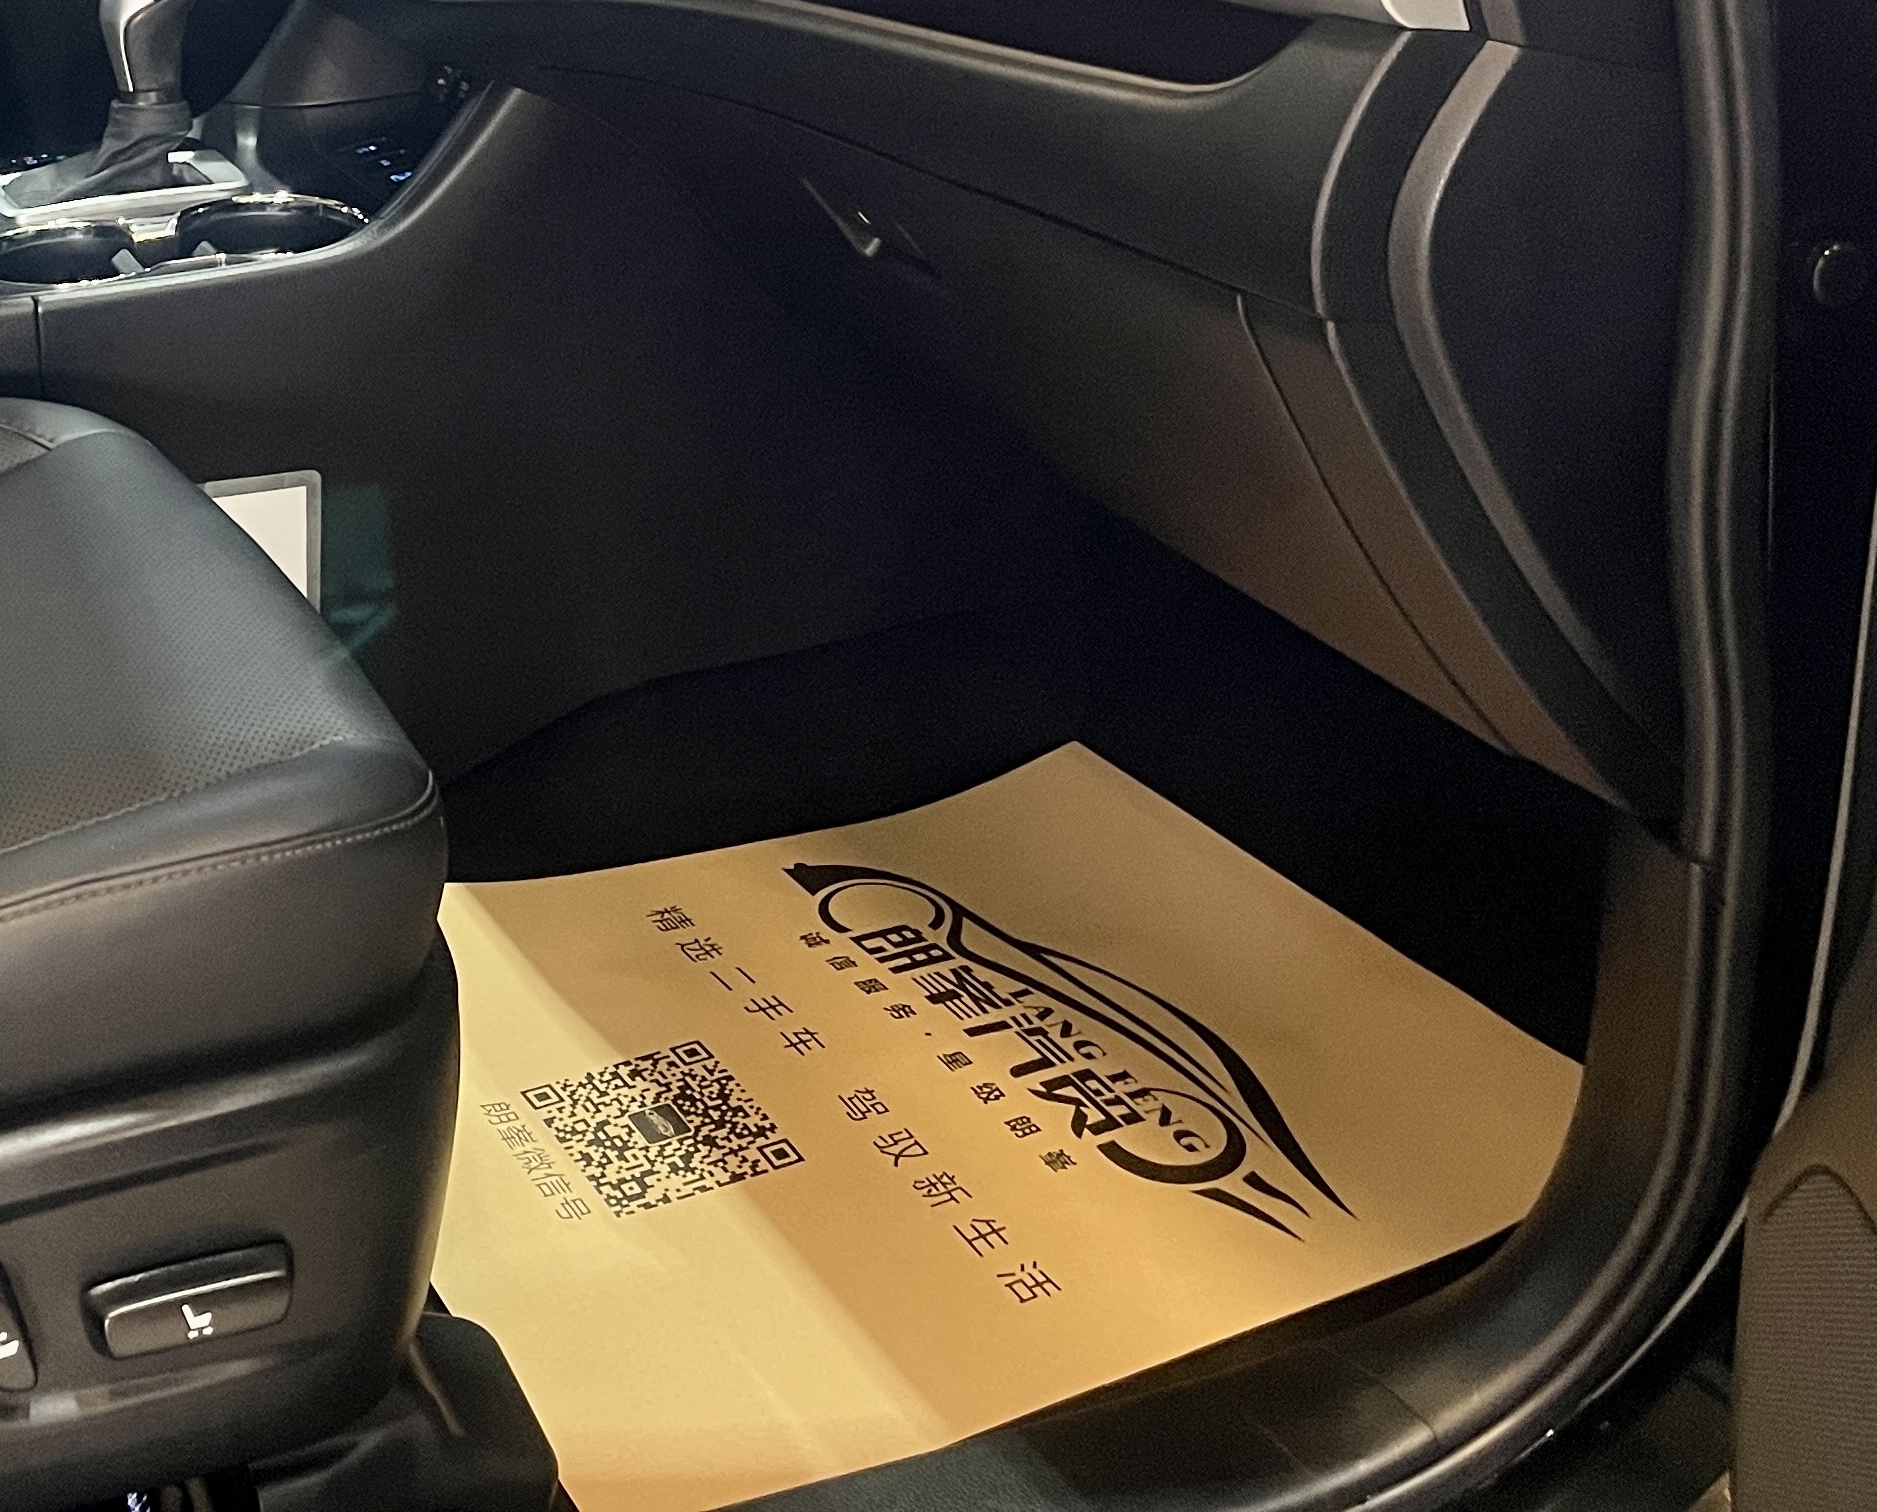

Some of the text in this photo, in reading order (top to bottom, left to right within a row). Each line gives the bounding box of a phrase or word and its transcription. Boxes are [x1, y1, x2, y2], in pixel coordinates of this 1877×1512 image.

[646, 905, 1062, 1303] 精选二手车 驾驭新生活
[1008, 988, 1210, 1153] LANG FENG
